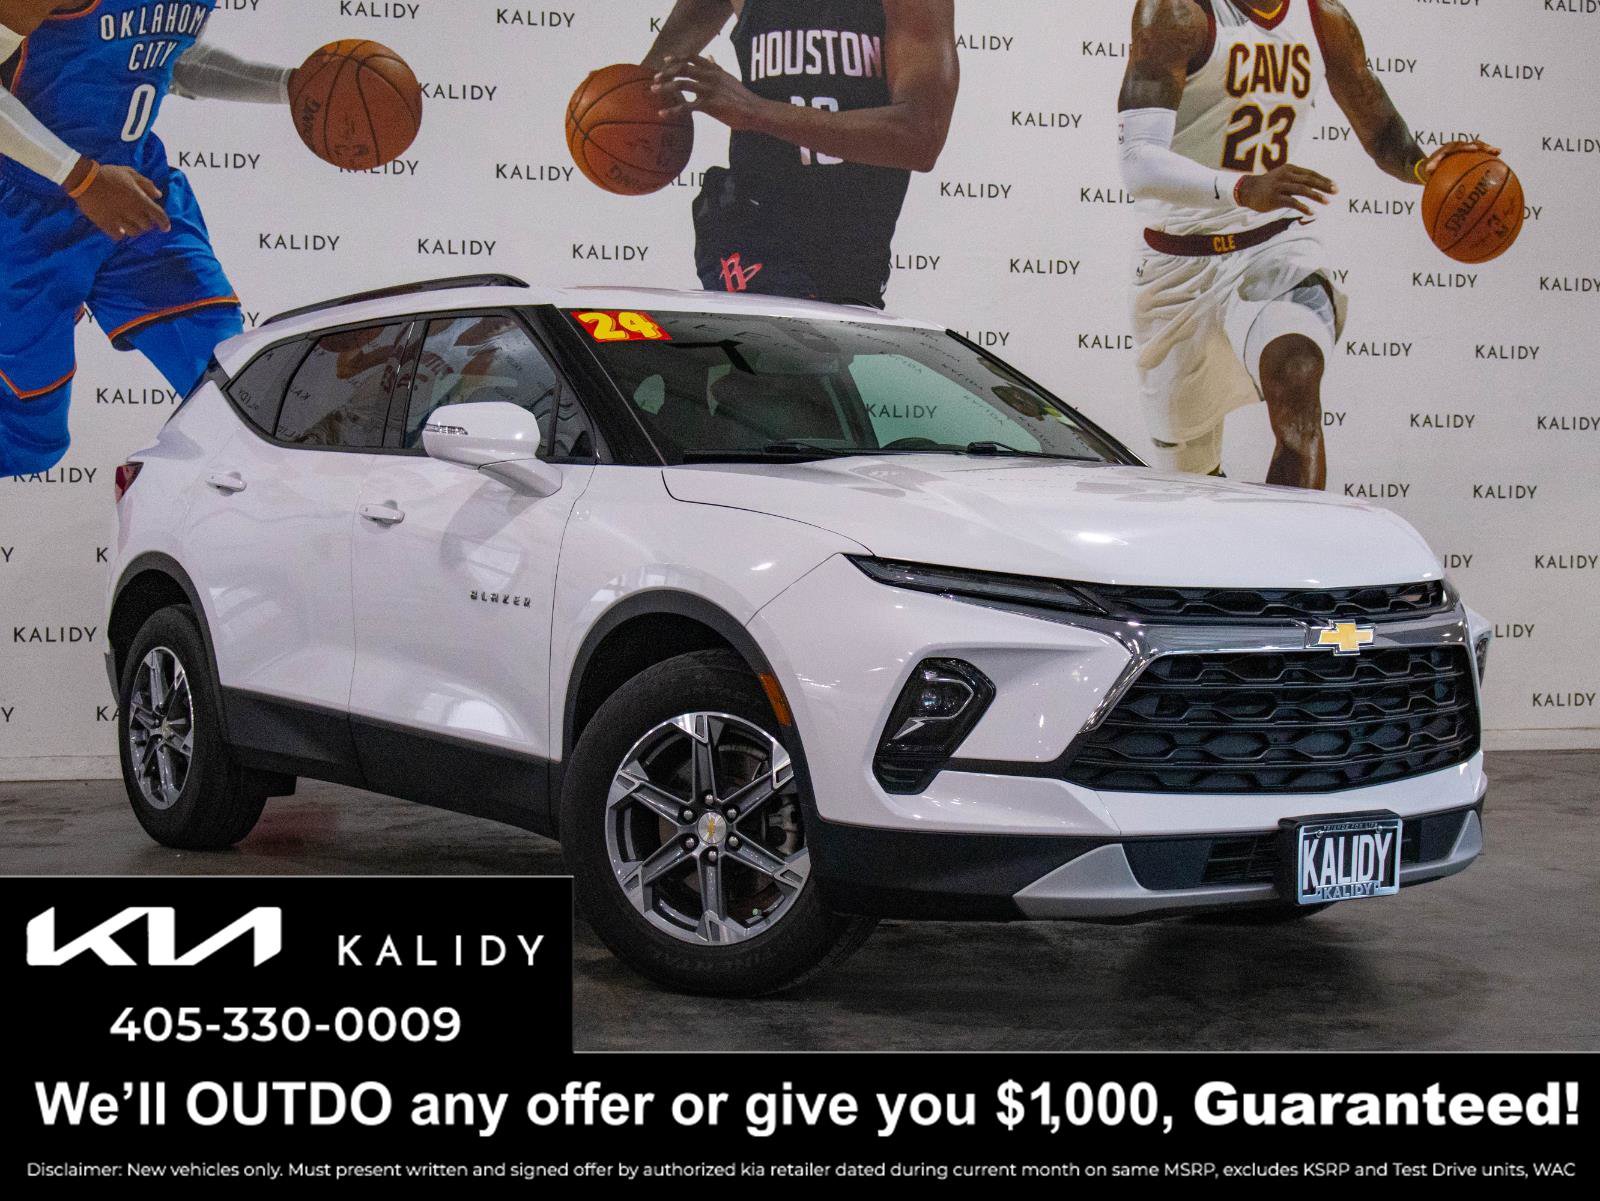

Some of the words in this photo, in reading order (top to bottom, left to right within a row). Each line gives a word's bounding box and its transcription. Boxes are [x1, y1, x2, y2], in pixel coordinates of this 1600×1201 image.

[214, 0, 259, 11] IDY
[340, 0, 419, 19] KALIDY
[1544, 0, 1600, 14] KALID
[101, 3, 206, 40] OKLAHOM
[496, 9, 575, 28] KALIDY
[956, 35, 1014, 51] ALIDY
[1082, 41, 1132, 57] KALI
[128, 41, 177, 71] CITY
[750, 29, 883, 82] HOUSTON
[1225, 42, 1311, 99] CAVS
[1366, 57, 1418, 73] ALIDY
[1480, 63, 1544, 81] KALIDY
[420, 83, 497, 101] KALIDY
[120, 83, 156, 142] 0
[1010, 111, 1083, 129] KALIDY
[1220, 103, 1296, 174] 23
[1312, 126, 1350, 141] IDY
[179, 151, 260, 169] KALIDY
[496, 164, 574, 181] KALIDY
[940, 182, 1012, 199] KALIDY
[1080, 187, 1136, 204] KALI
[1349, 199, 1415, 215] KALIDY
[259, 233, 340, 250] KALIDY
[417, 239, 496, 256] KALIDY
[1213, 234, 1236, 252] CLE
[572, 244, 649, 261] KALIDY
[890, 254, 940, 270] LIDY
[1009, 259, 1080, 275] KALIDY
[1412, 273, 1477, 288] KALIDY
[1539, 276, 1600, 292] KALIDY
[957, 331, 1010, 346] IDY
[1078, 334, 1133, 350] KALID
[1346, 341, 1412, 357] KALIDY
[1475, 345, 1539, 360] KALIDY
[97, 388, 178, 405] KALIDY
[866, 403, 937, 419] KALIDY
[1410, 414, 1475, 429] KALIDY
[1537, 416, 1600, 431] KALIDY
[1344, 483, 1410, 498] KALIDY
[1473, 485, 1538, 499] KALIDY
[1443, 554, 1473, 568] IDY
[1534, 555, 1598, 569] KALIDY
[470, 590, 531, 608] BLAZER
[13, 627, 97, 643] KALIDY
[1495, 624, 1535, 638] LIDY
[1532, 693, 1596, 707] KALIDY
[1303, 832, 1393, 890] KALIDY
[1324, 882, 1373, 899] KALIDY
